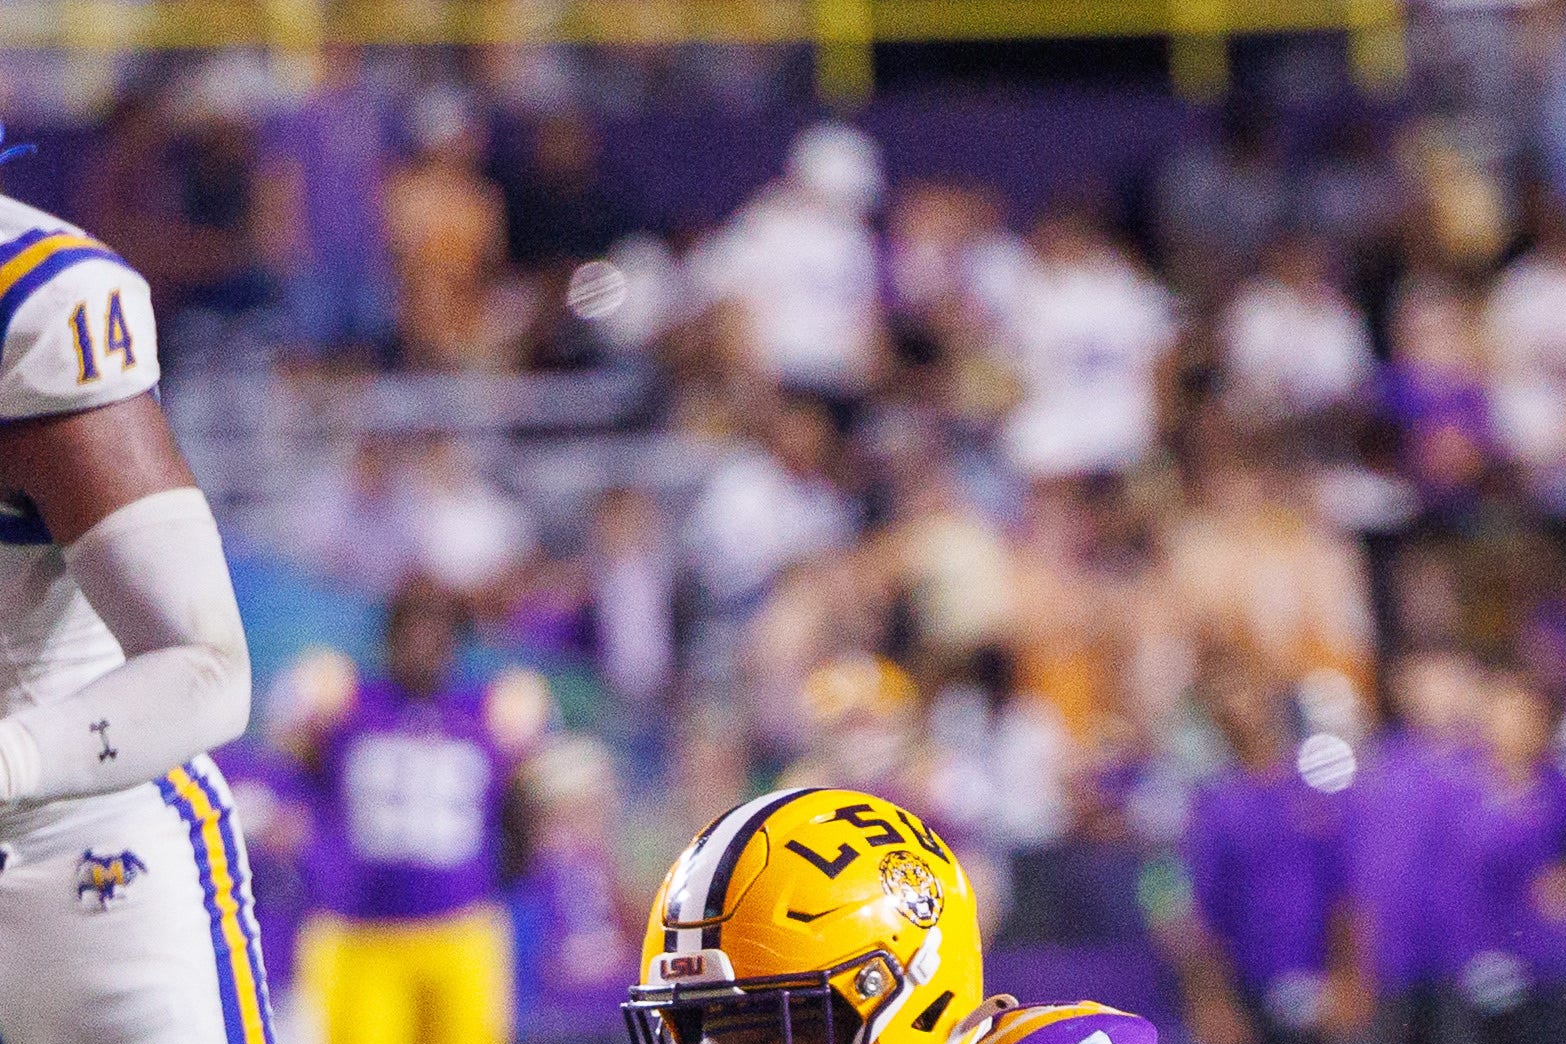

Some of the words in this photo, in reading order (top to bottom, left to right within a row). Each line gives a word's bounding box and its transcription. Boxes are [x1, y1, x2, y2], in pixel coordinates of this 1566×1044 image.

[67, 287, 138, 386] 14
[784, 802, 952, 880] LSU
[659, 954, 706, 980] LSU
